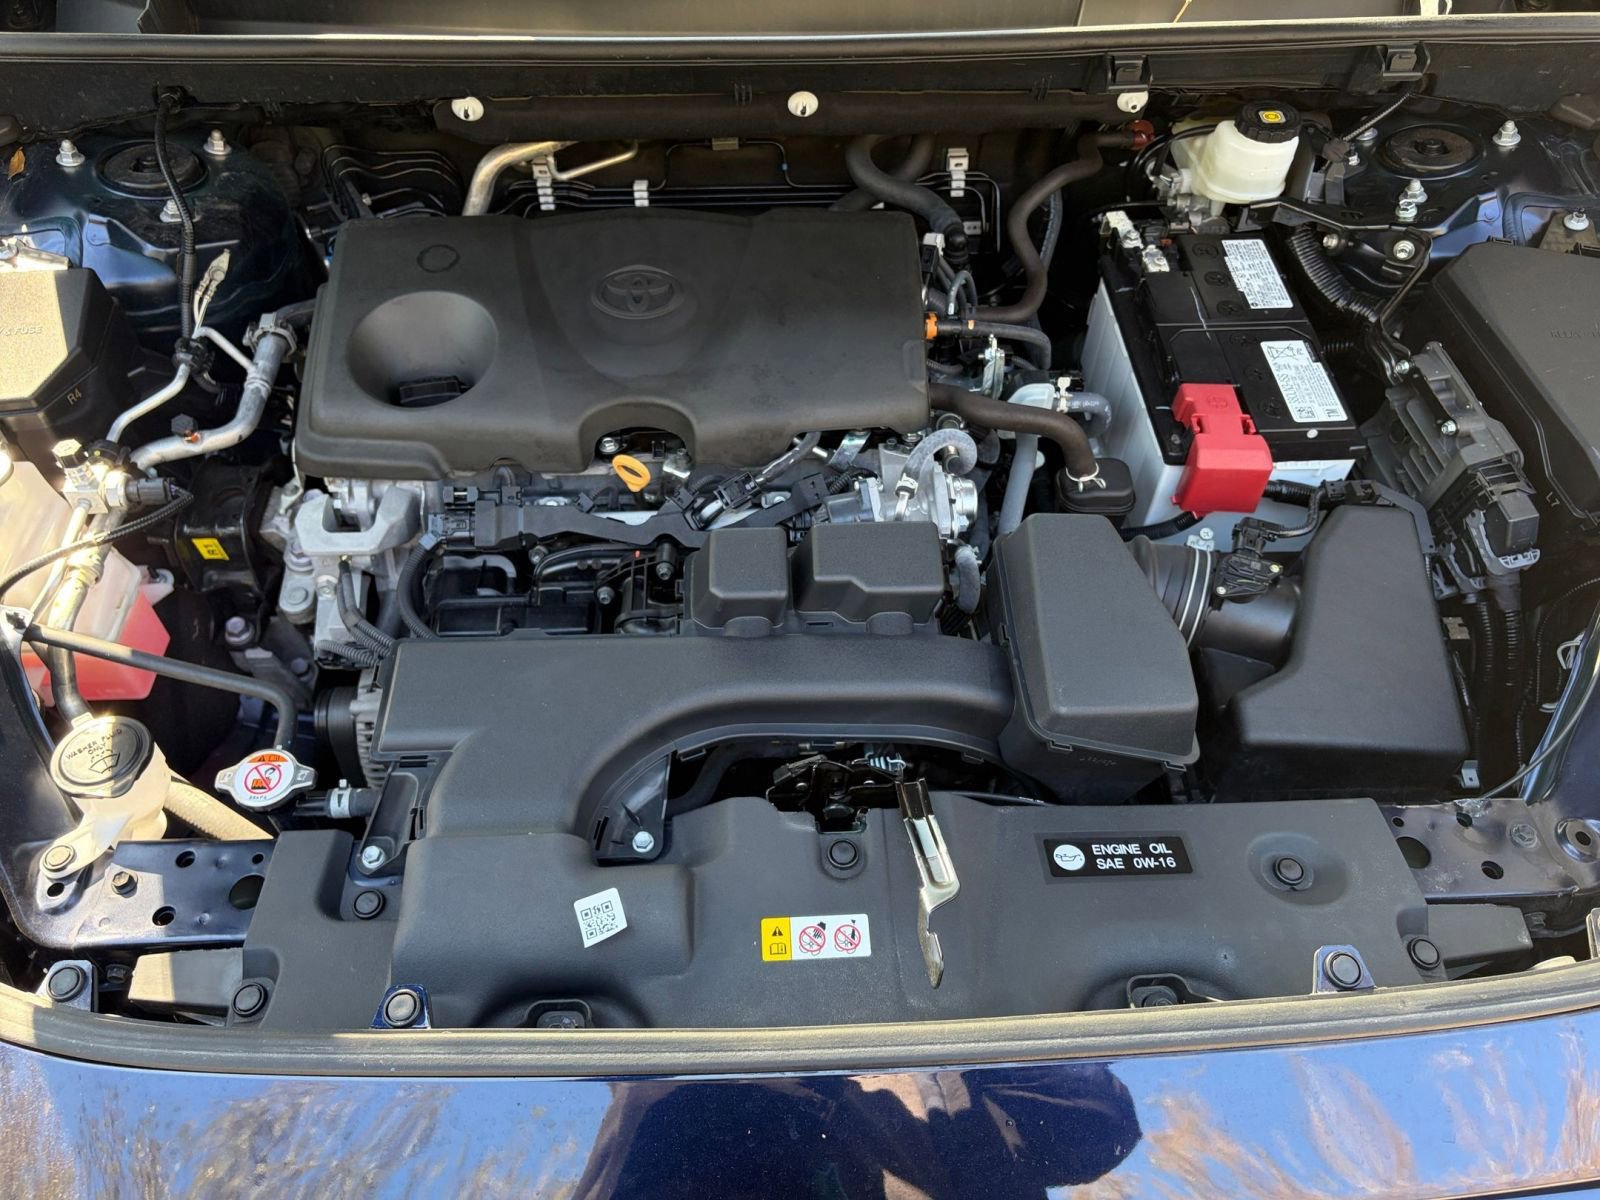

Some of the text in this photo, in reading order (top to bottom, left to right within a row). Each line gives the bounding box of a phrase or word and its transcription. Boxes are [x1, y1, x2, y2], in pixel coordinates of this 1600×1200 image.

[14, 326, 43, 336] FUSE
[66, 388, 82, 405] R4
[1091, 842, 1172, 856] ENGINE OIL
[1096, 856, 1177, 870] SAE 0W-16
